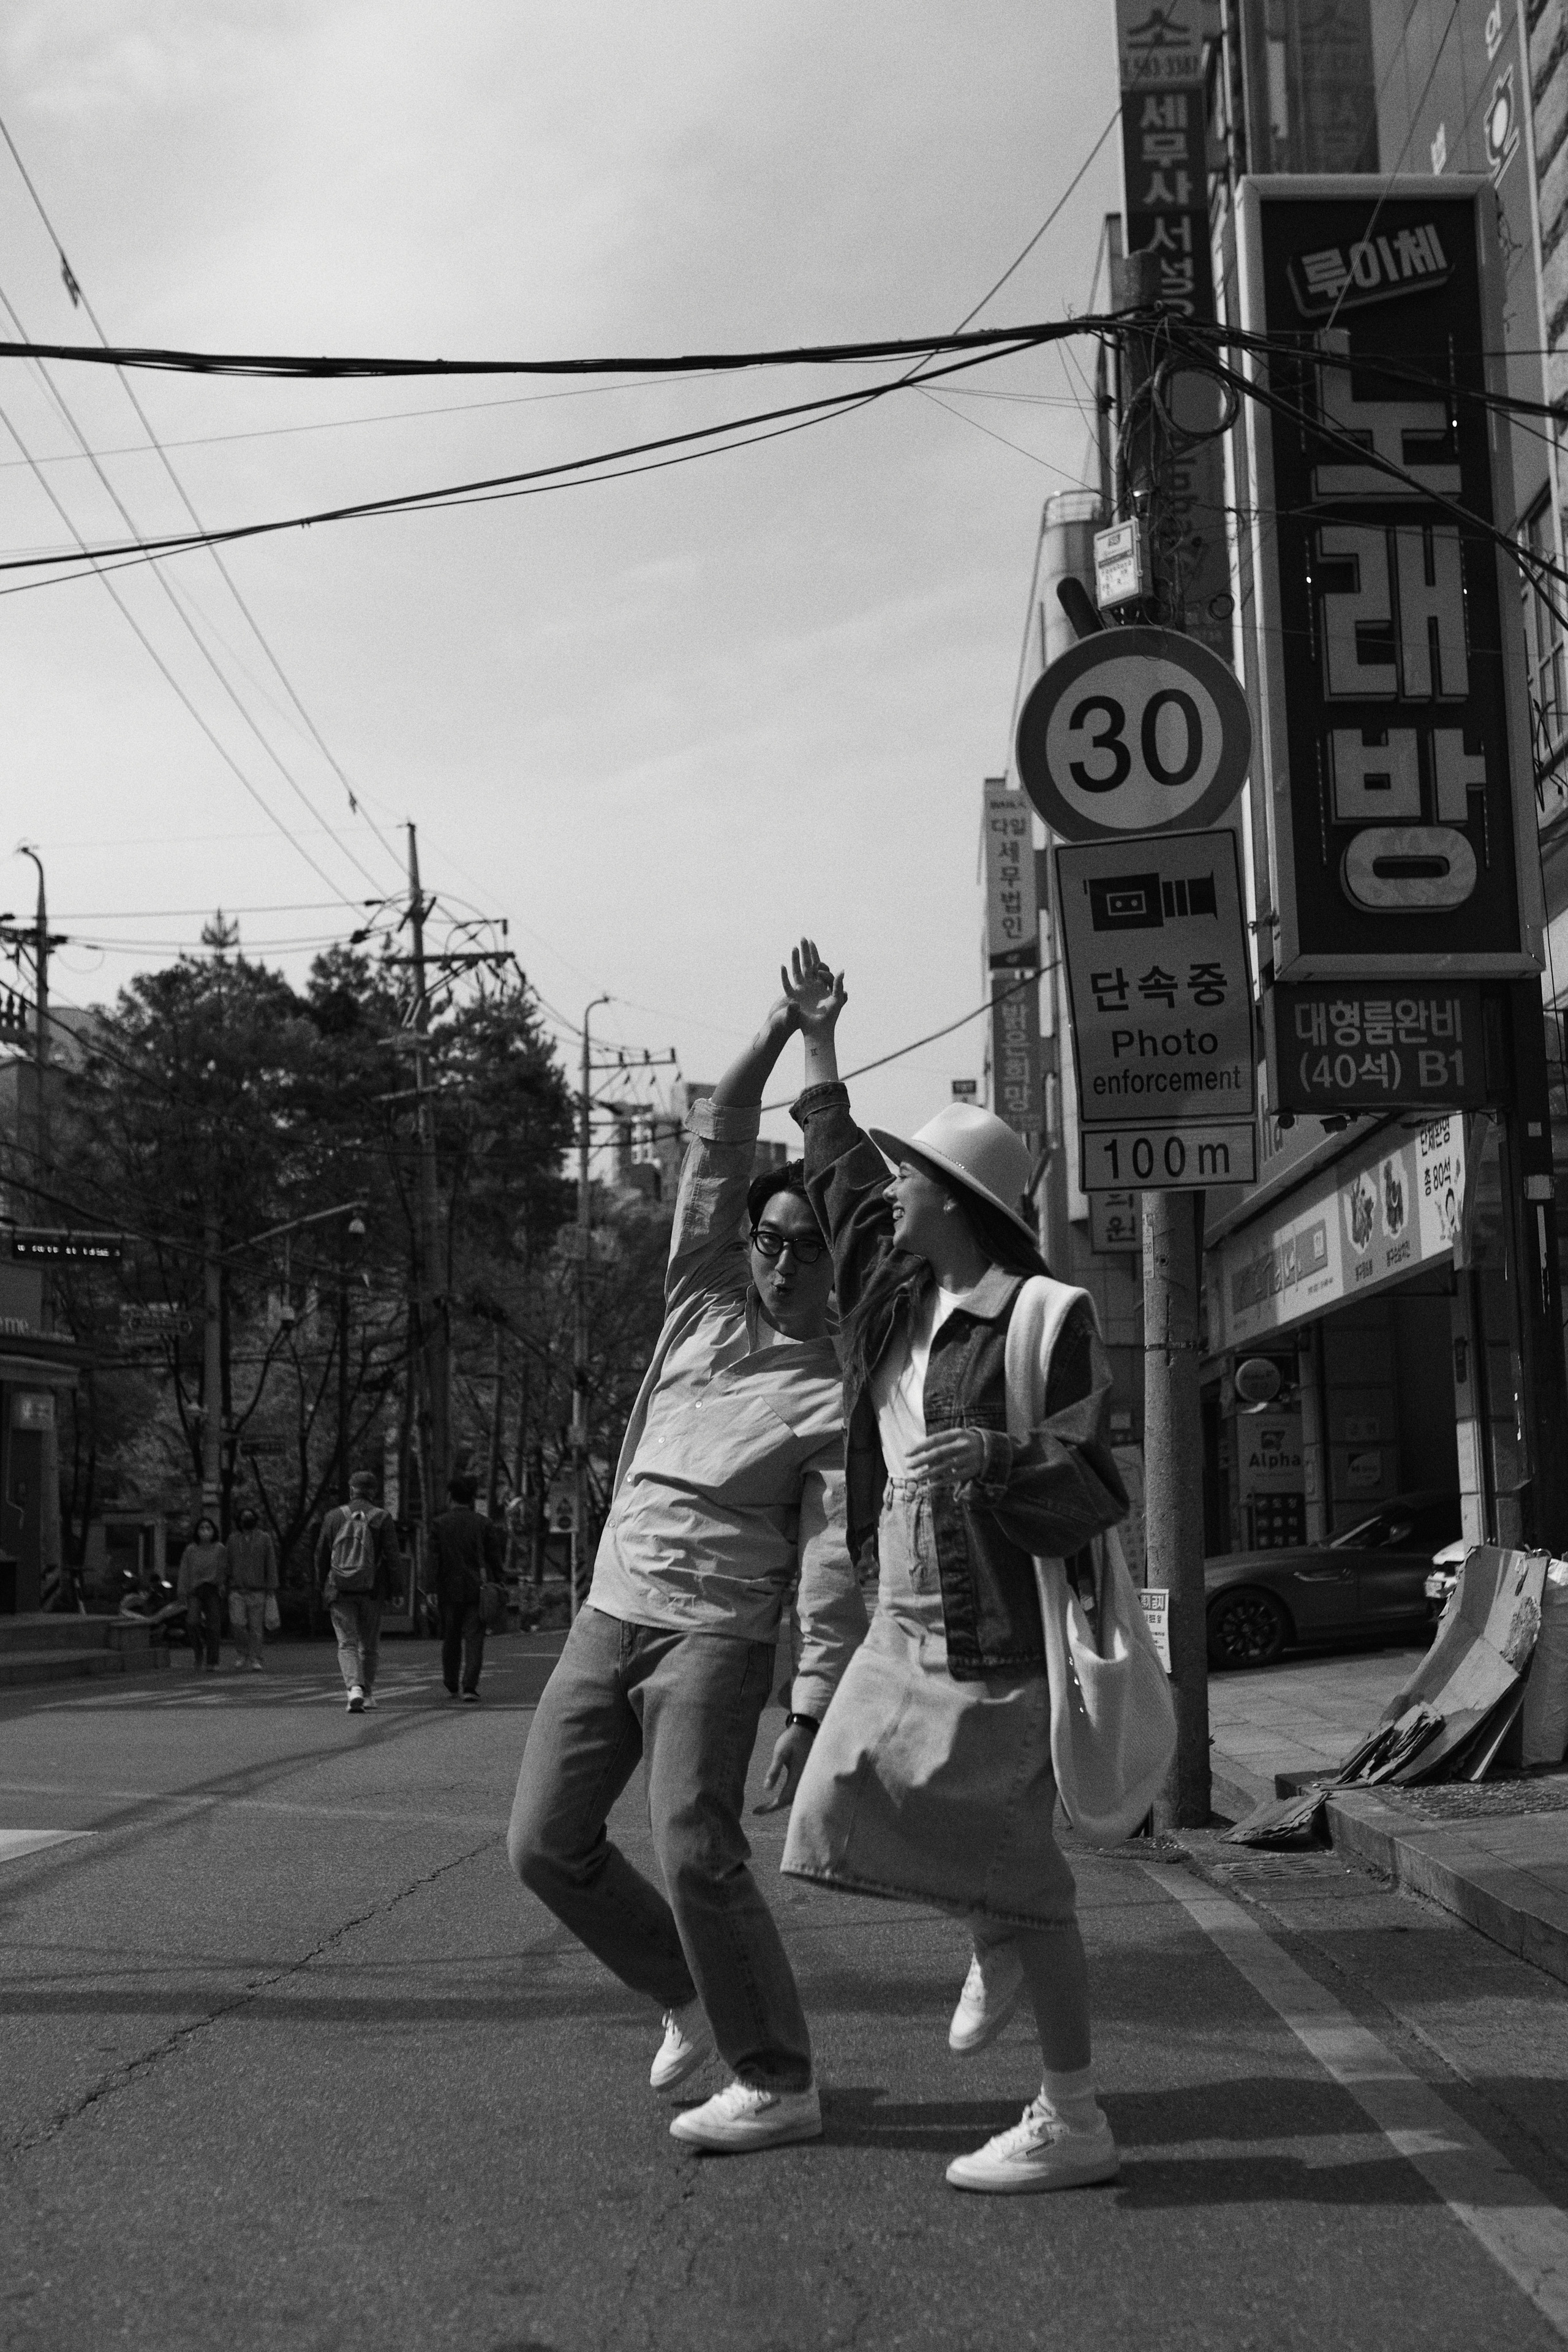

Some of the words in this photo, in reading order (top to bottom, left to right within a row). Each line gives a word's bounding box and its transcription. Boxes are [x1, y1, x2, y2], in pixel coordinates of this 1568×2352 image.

[1141, 94, 1193, 206] 세무사
[1301, 223, 1449, 299] 루이체
[1312, 326, 1488, 913] 노래방
[1069, 688, 1202, 793] 30
[997, 840, 1023, 940] 세무법인
[1090, 962, 1227, 1012] 단속중
[1112, 1029, 1218, 1058] Photo
[1294, 998, 1462, 1047] 대형룸완비
[1093, 1066, 1240, 1095] enforcement
[1300, 1049, 1401, 1093] (40석)
[1418, 1049, 1464, 1087] B1
[1104, 1136, 1229, 1179] 100m
[1433, 1156, 1451, 1191] 80석
[1248, 1451, 1302, 1470] Alpha
